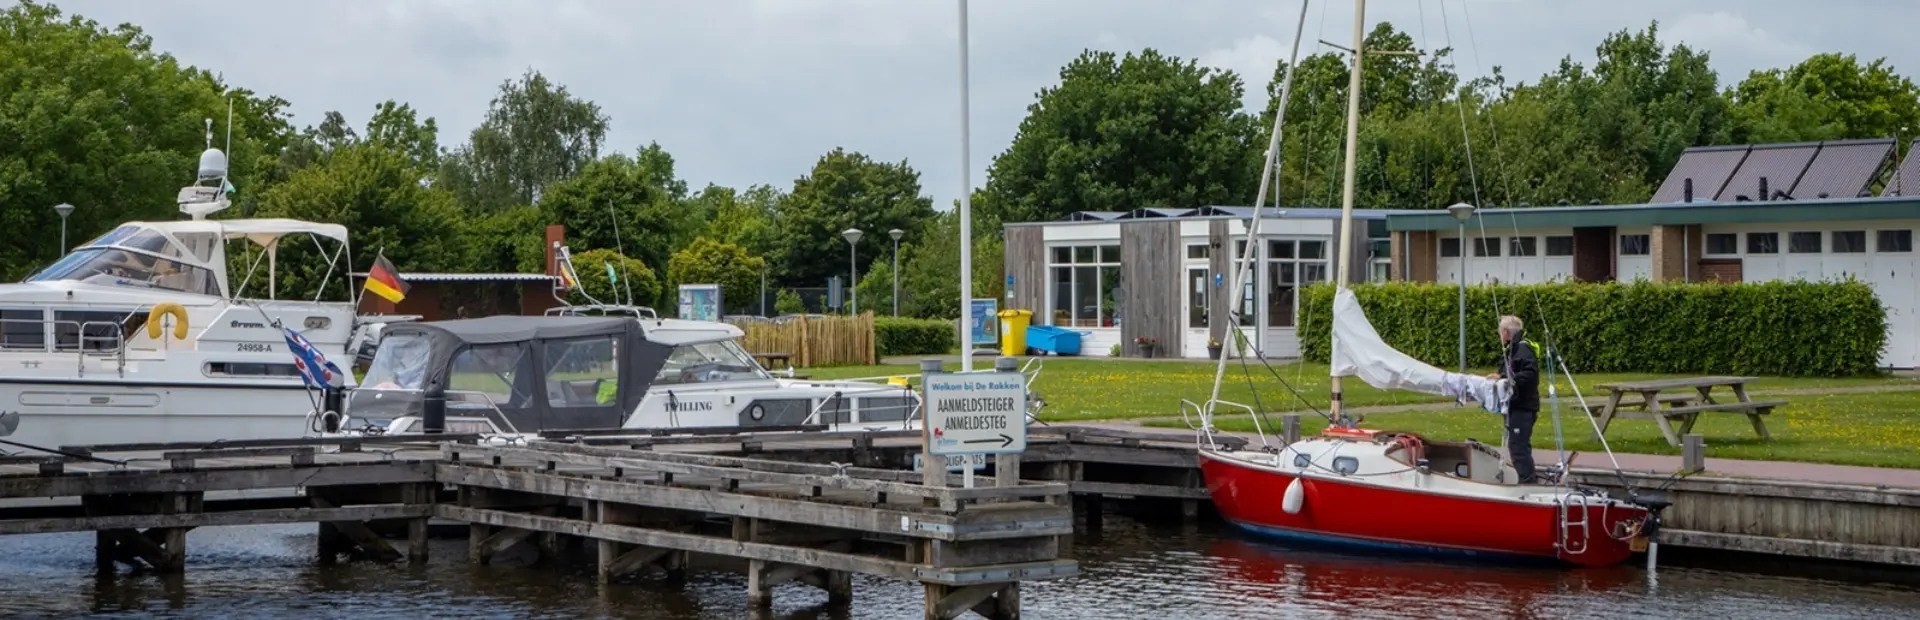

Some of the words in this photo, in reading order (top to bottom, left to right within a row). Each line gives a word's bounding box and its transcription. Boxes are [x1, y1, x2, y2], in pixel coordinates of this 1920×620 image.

[237, 343, 272, 352] 24958-A
[931, 382, 962, 391] Welkom
[964, 381, 974, 392] bij
[975, 382, 986, 390] De
[937, 397, 1015, 412] AANMELDSTEIGER
[944, 415, 1007, 430] ANMELDESTEG
